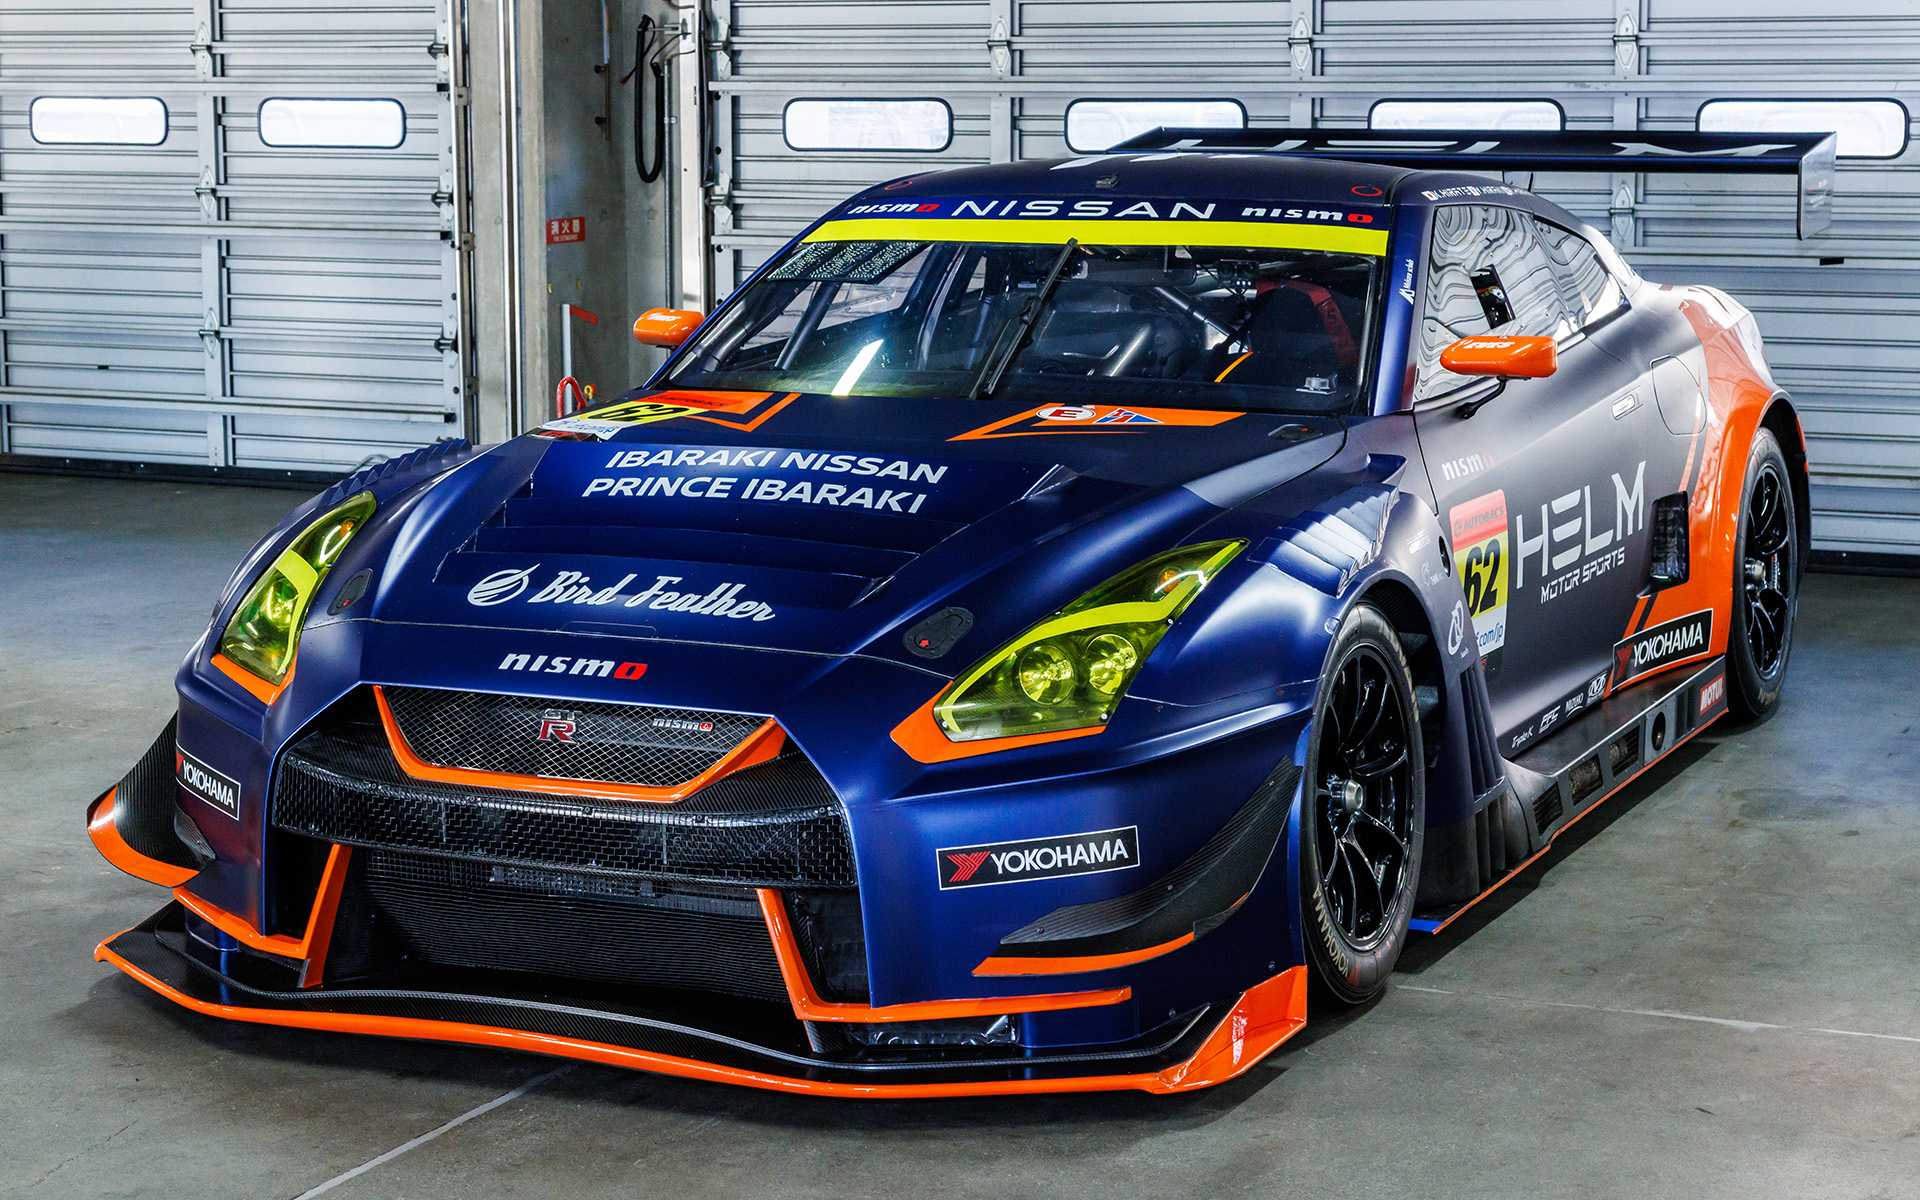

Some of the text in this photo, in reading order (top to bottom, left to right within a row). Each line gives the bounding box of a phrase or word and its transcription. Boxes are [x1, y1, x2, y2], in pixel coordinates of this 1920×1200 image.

[848, 202, 938, 215] nismo
[951, 199, 1217, 220] NISSAN
[1241, 206, 1374, 223] nismo
[605, 450, 948, 484] IBARAKI NISSAN
[1442, 450, 1495, 481] nismo
[582, 477, 927, 514] PRINCE IBARAKI
[1463, 505, 1505, 532] AUTOBACS
[1516, 460, 1647, 590] HELM
[1464, 538, 1501, 618] 62
[1541, 546, 1626, 604] MOTOR SPORTS
[527, 571, 776, 622] Bird Feather
[1633, 622, 1703, 668] YOKOHAMA
[499, 653, 648, 681] nismo
[1701, 676, 1725, 712] MOTUL
[652, 718, 714, 732] nismo
[183, 759, 235, 809] YOKOHAMA
[991, 838, 1129, 875] YOKOHAMA
[1312, 880, 1351, 978] YOKOHAMA
